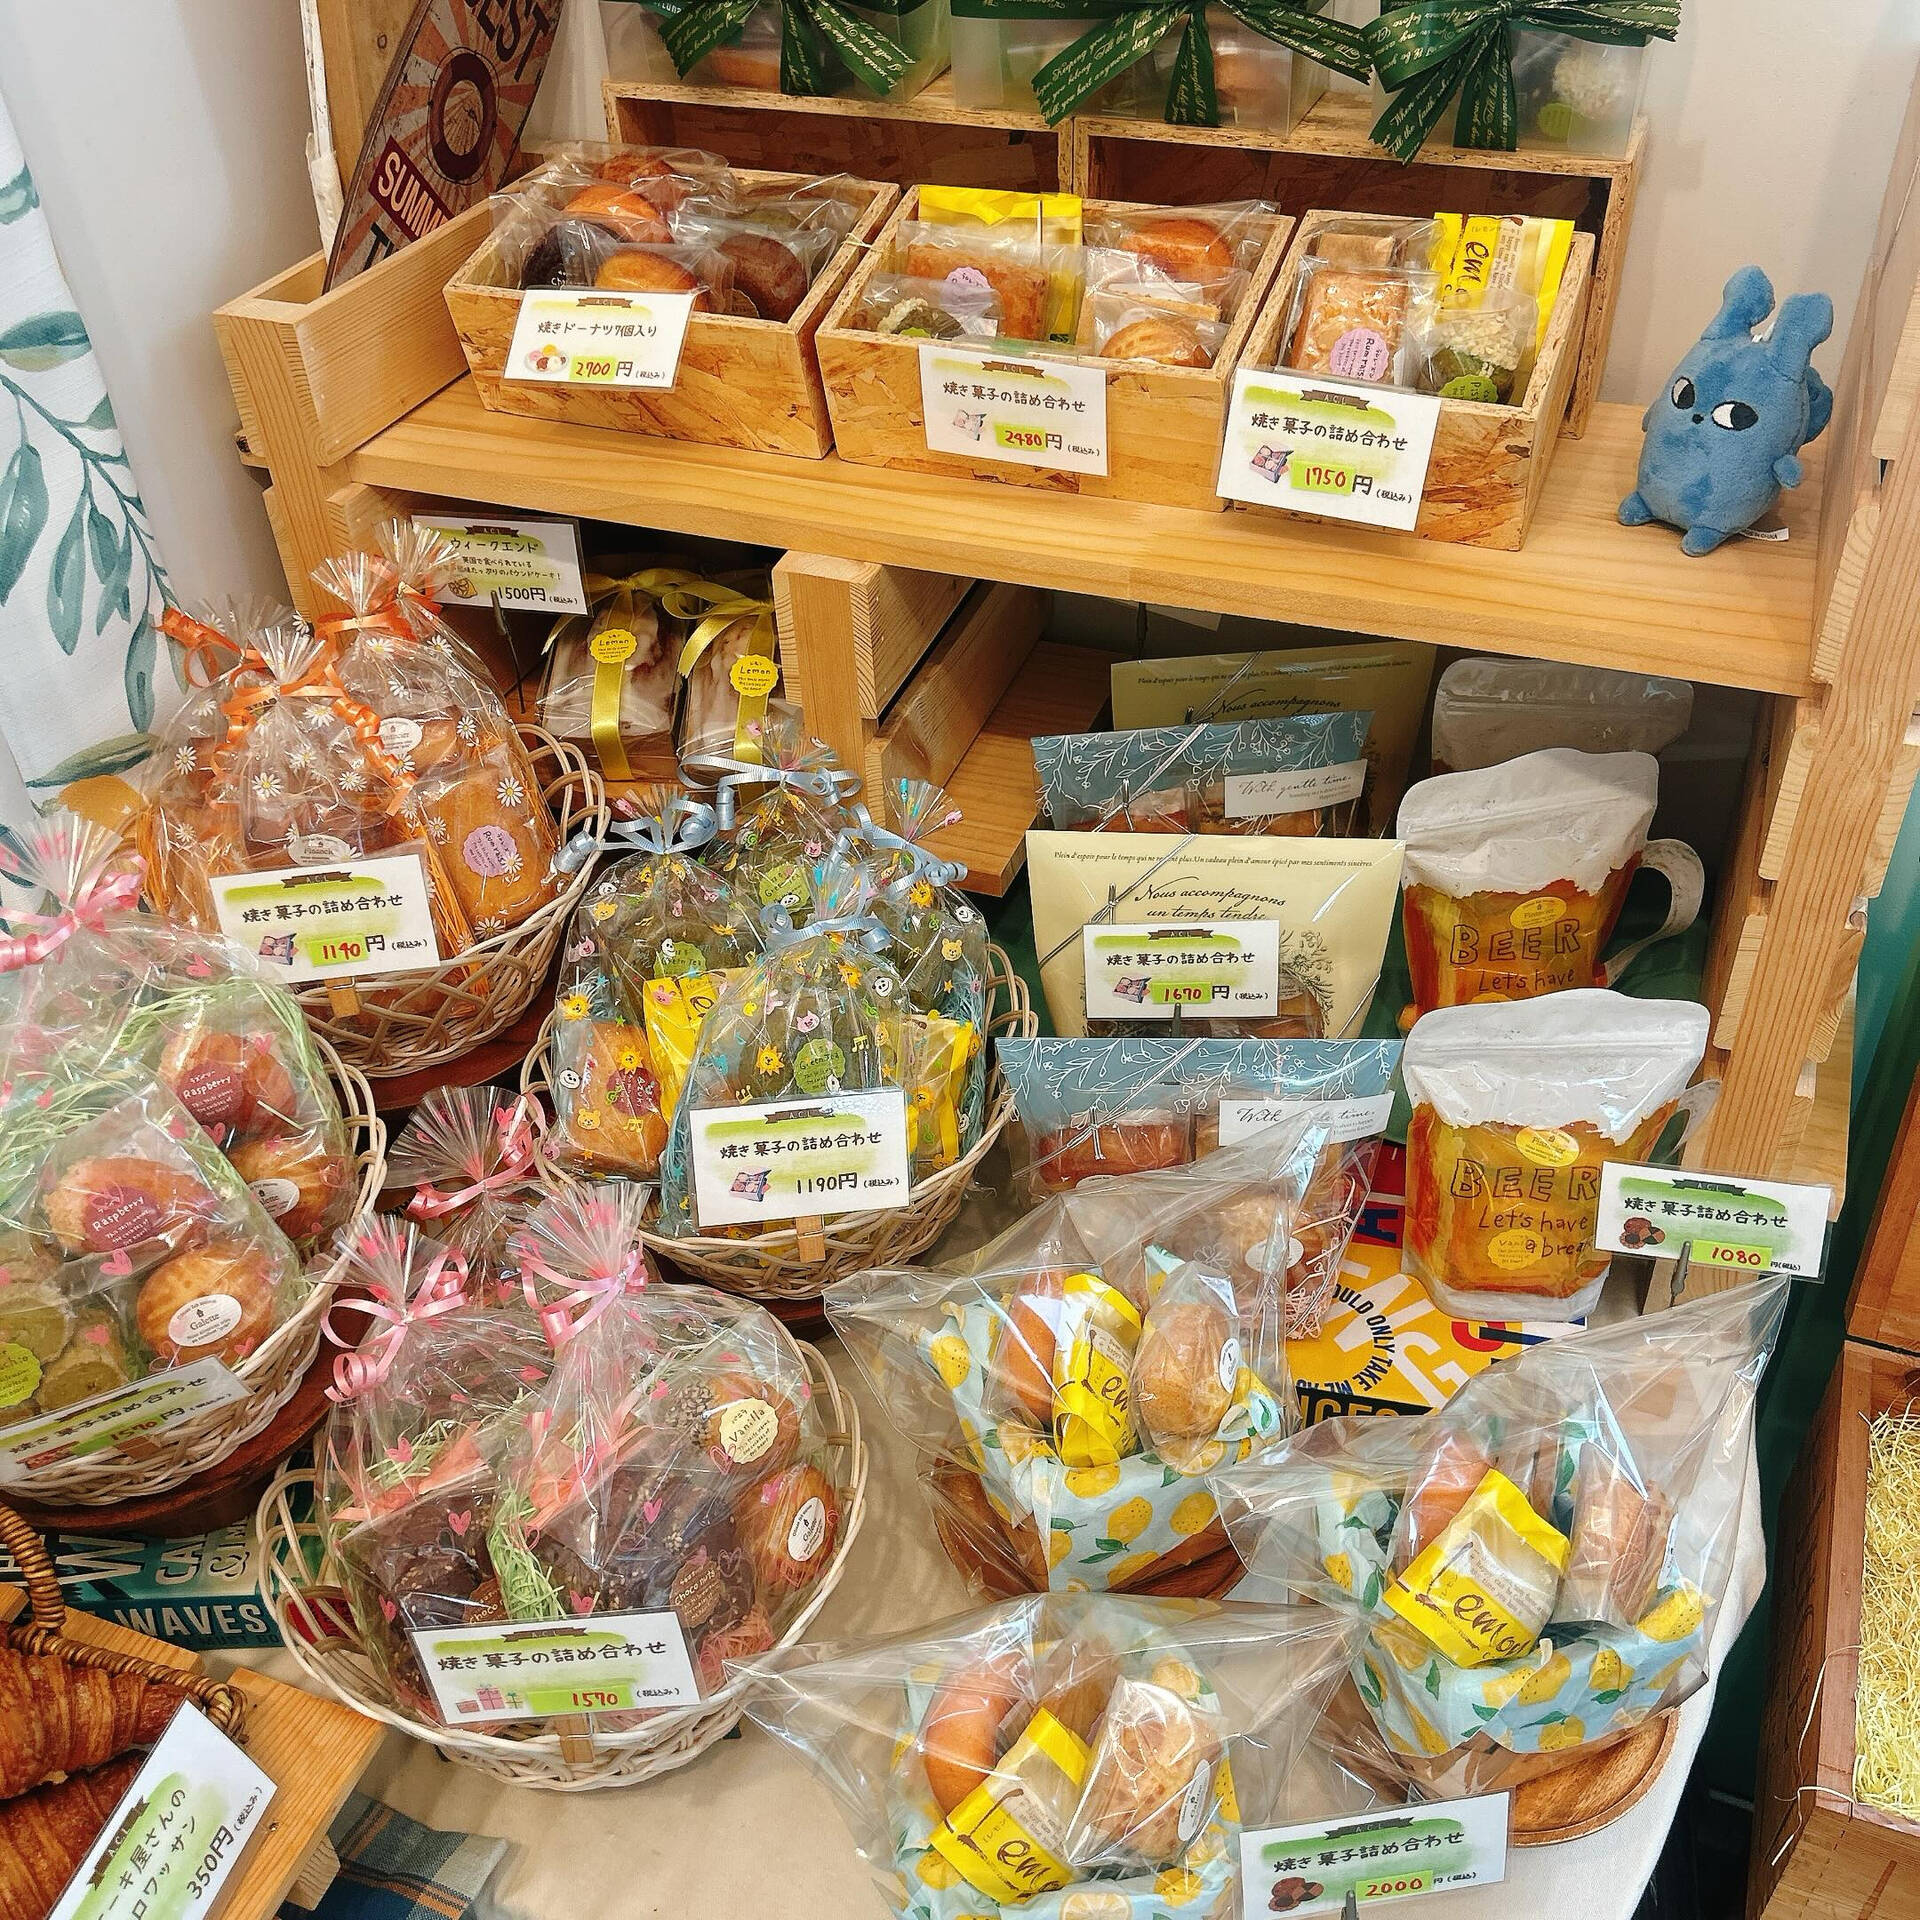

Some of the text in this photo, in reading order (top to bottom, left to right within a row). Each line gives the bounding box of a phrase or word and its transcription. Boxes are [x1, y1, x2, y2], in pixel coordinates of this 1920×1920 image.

[943, 381, 1086, 412] 焼き菓子の詰め合わせ
[1251, 412, 1409, 451] 焼き菓子の詰め合わせ
[450, 537, 539, 554] ウィークエンド
[498, 586, 546, 601] 1500円
[1288, 859, 1300, 868] par
[243, 894, 404, 923] 焼き菓子の詰め合わせ
[1180, 885, 1286, 907] accompagnons
[1170, 905, 1215, 922] temps
[1450, 918, 1581, 965] BEER
[1106, 951, 1256, 967] 焼き菓子の詰め合わせ
[1478, 968, 1575, 992] Let's have
[183, 1075, 231, 1100] Raspberry
[720, 1131, 882, 1159] 焼き菓子の詰め合わせ
[796, 1172, 858, 1194] 1190円
[1451, 1158, 1601, 1202] BEER
[92, 1196, 145, 1232] Raspberry
[1478, 1204, 1588, 1232] Let's have
[1624, 1197, 1789, 1229] 焼き菓子詰め合わせ
[1542, 1236, 1591, 1259] brea
[1712, 1247, 1762, 1266] 1080
[1332, 1283, 1374, 1316] OULD
[189, 1312, 221, 1331] Galette
[1366, 1314, 1396, 1354] ONLY
[1352, 1354, 1393, 1393] TAKE
[729, 1408, 766, 1443] Vanilla
[115, 1604, 267, 1637] WAVES
[437, 1641, 667, 1671] 焼き菓子の詰め合わせ
[572, 1692, 618, 1707] 1570
[97, 1789, 186, 1920] ーキ屋さんの
[186, 1825, 235, 1899] 350円
[1274, 1832, 1465, 1873] 焼き菓子詰め合わせ
[1365, 1877, 1423, 1897] 2000
